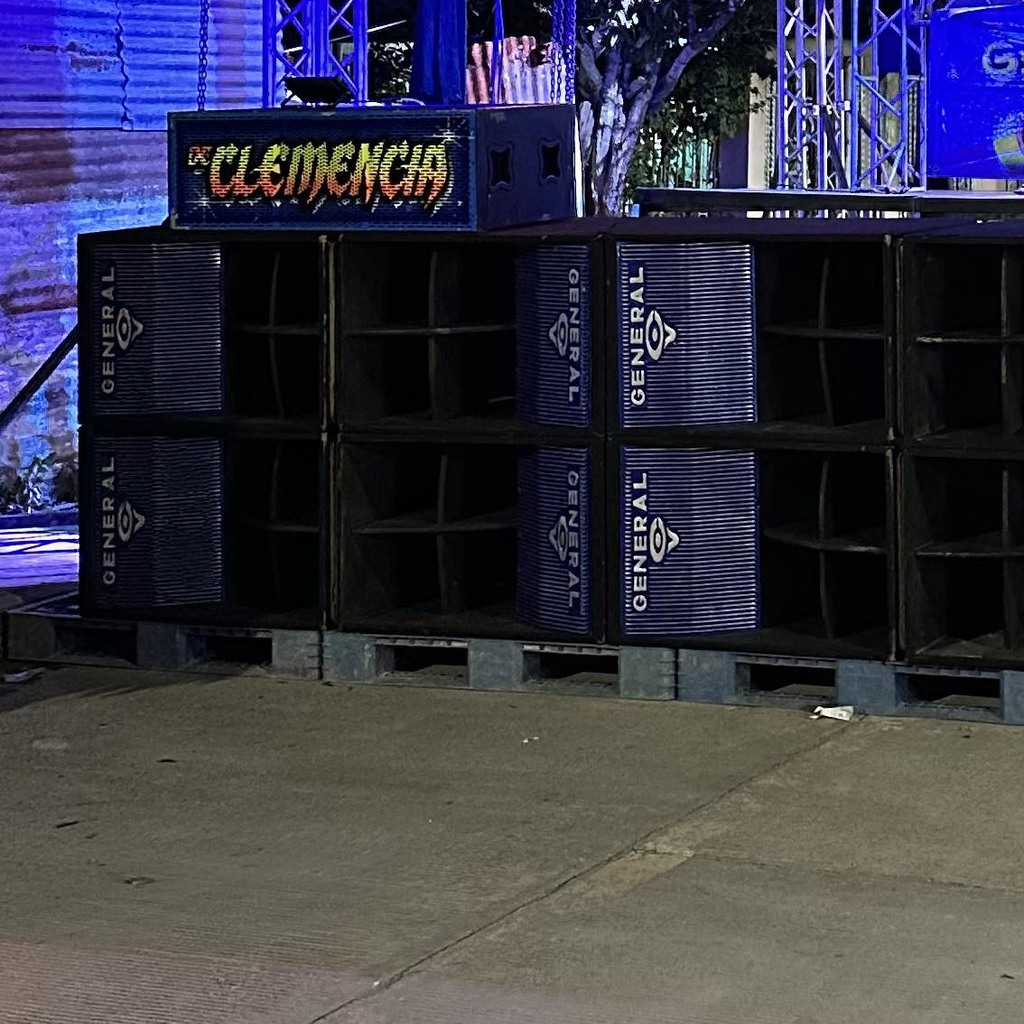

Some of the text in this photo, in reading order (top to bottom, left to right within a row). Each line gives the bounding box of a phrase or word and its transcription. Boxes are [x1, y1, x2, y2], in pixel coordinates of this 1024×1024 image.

[209, 140, 450, 207] CLEMENCIA
[102, 266, 115, 394] GENERAL
[568, 268, 580, 403] GENERAL
[630, 266, 644, 406] GENERAL
[103, 456, 116, 585] GENERAL
[567, 470, 580, 608] GENERAL
[632, 473, 647, 612] GENERAL
